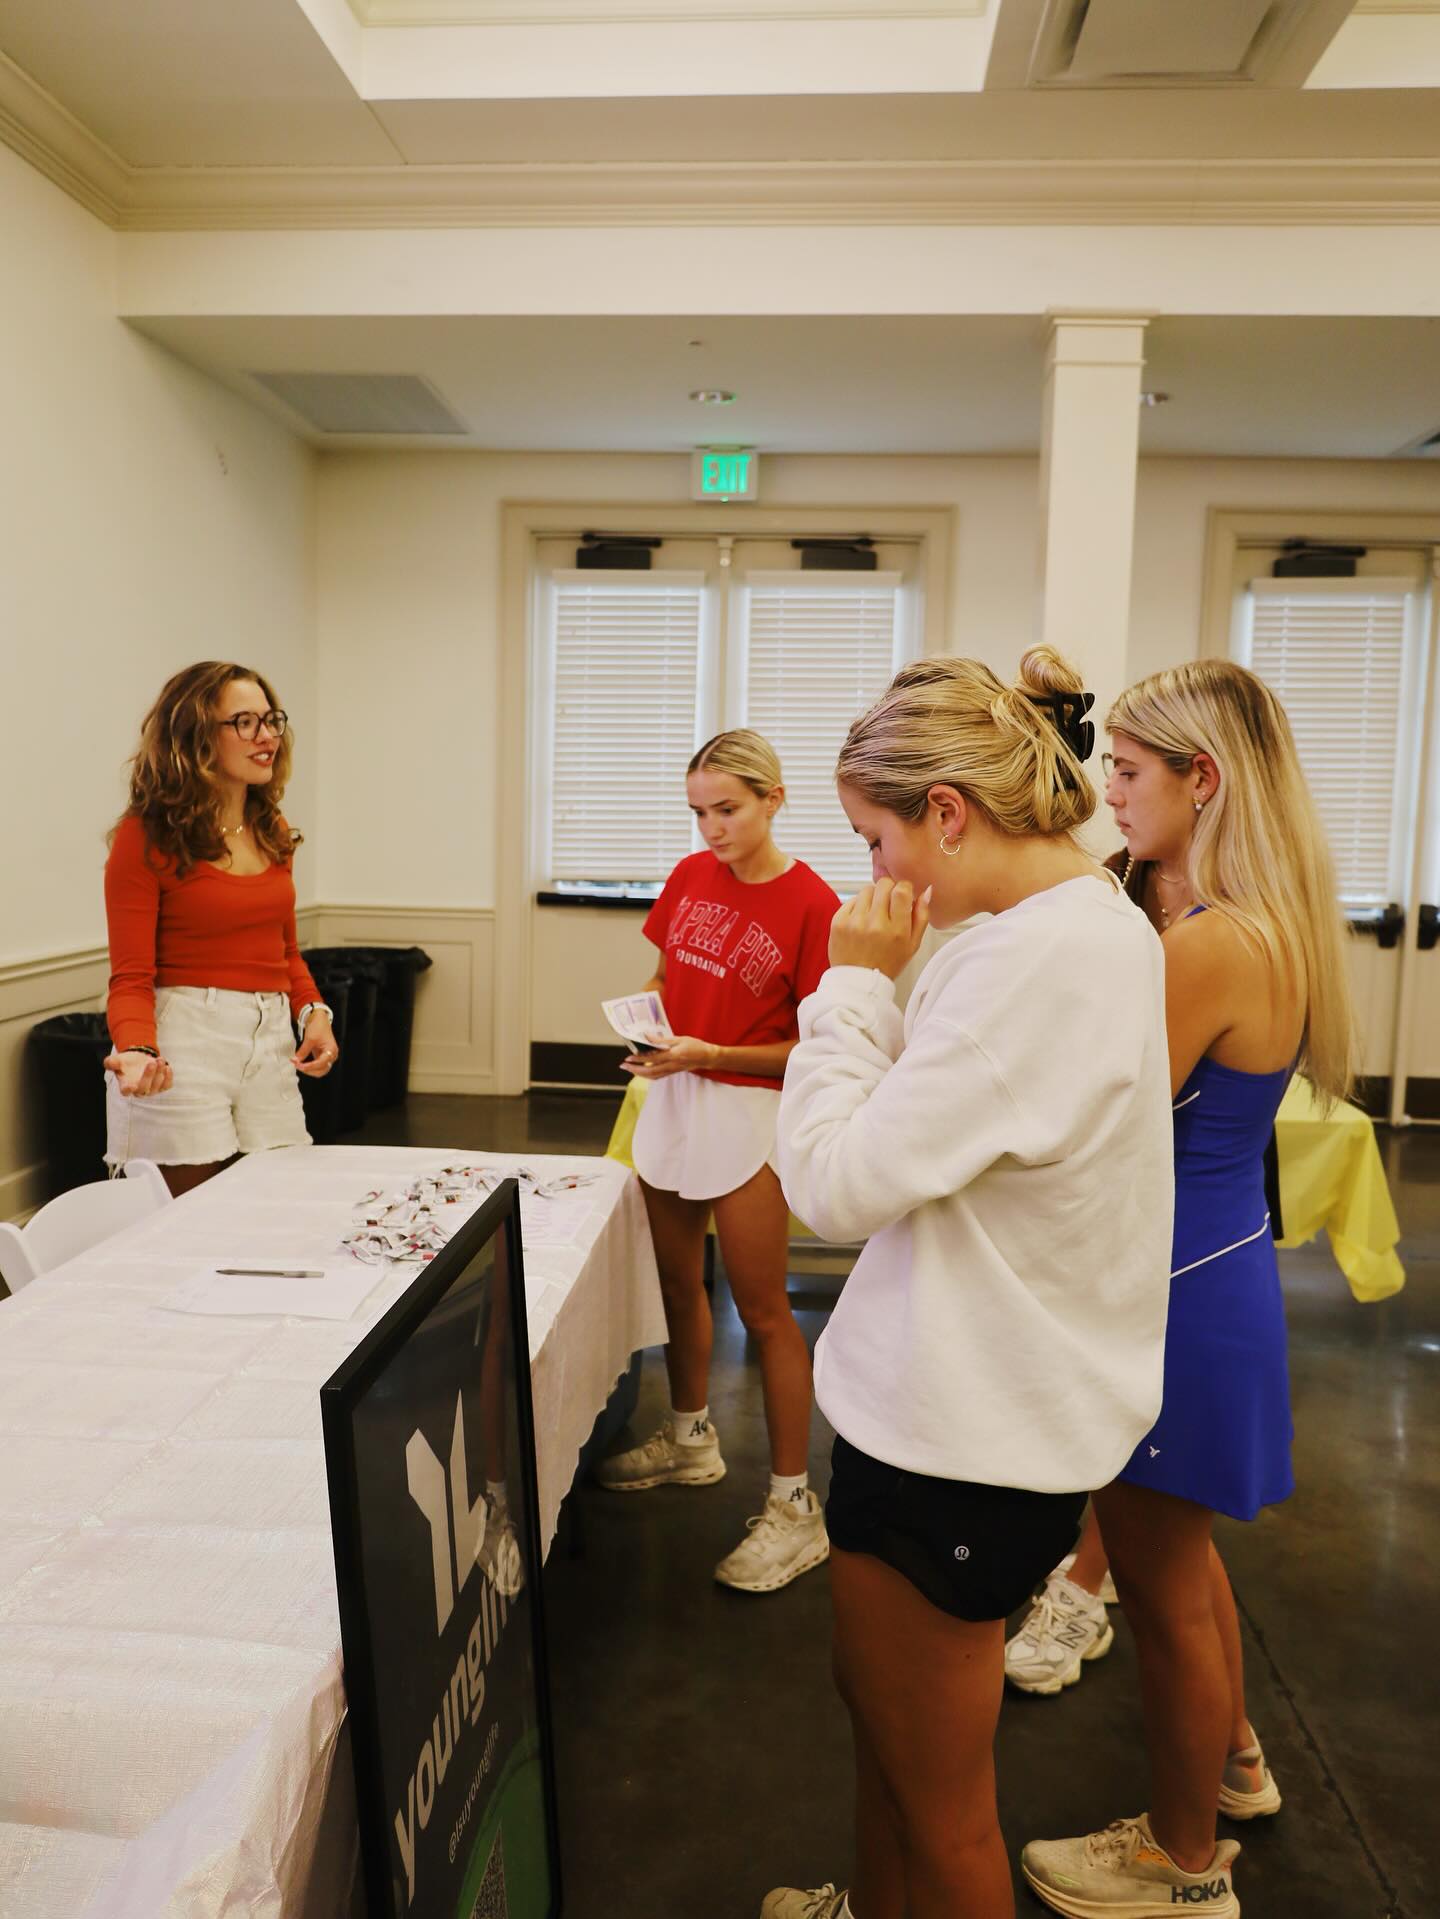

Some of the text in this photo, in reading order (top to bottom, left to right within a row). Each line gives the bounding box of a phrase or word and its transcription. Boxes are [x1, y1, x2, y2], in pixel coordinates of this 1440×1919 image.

[666, 895, 782, 997] LPHA PHI
[676, 948, 727, 979] FOUNDATION
[393, 1565, 518, 1908] youngli
[1171, 1878, 1228, 1904] HOKA
